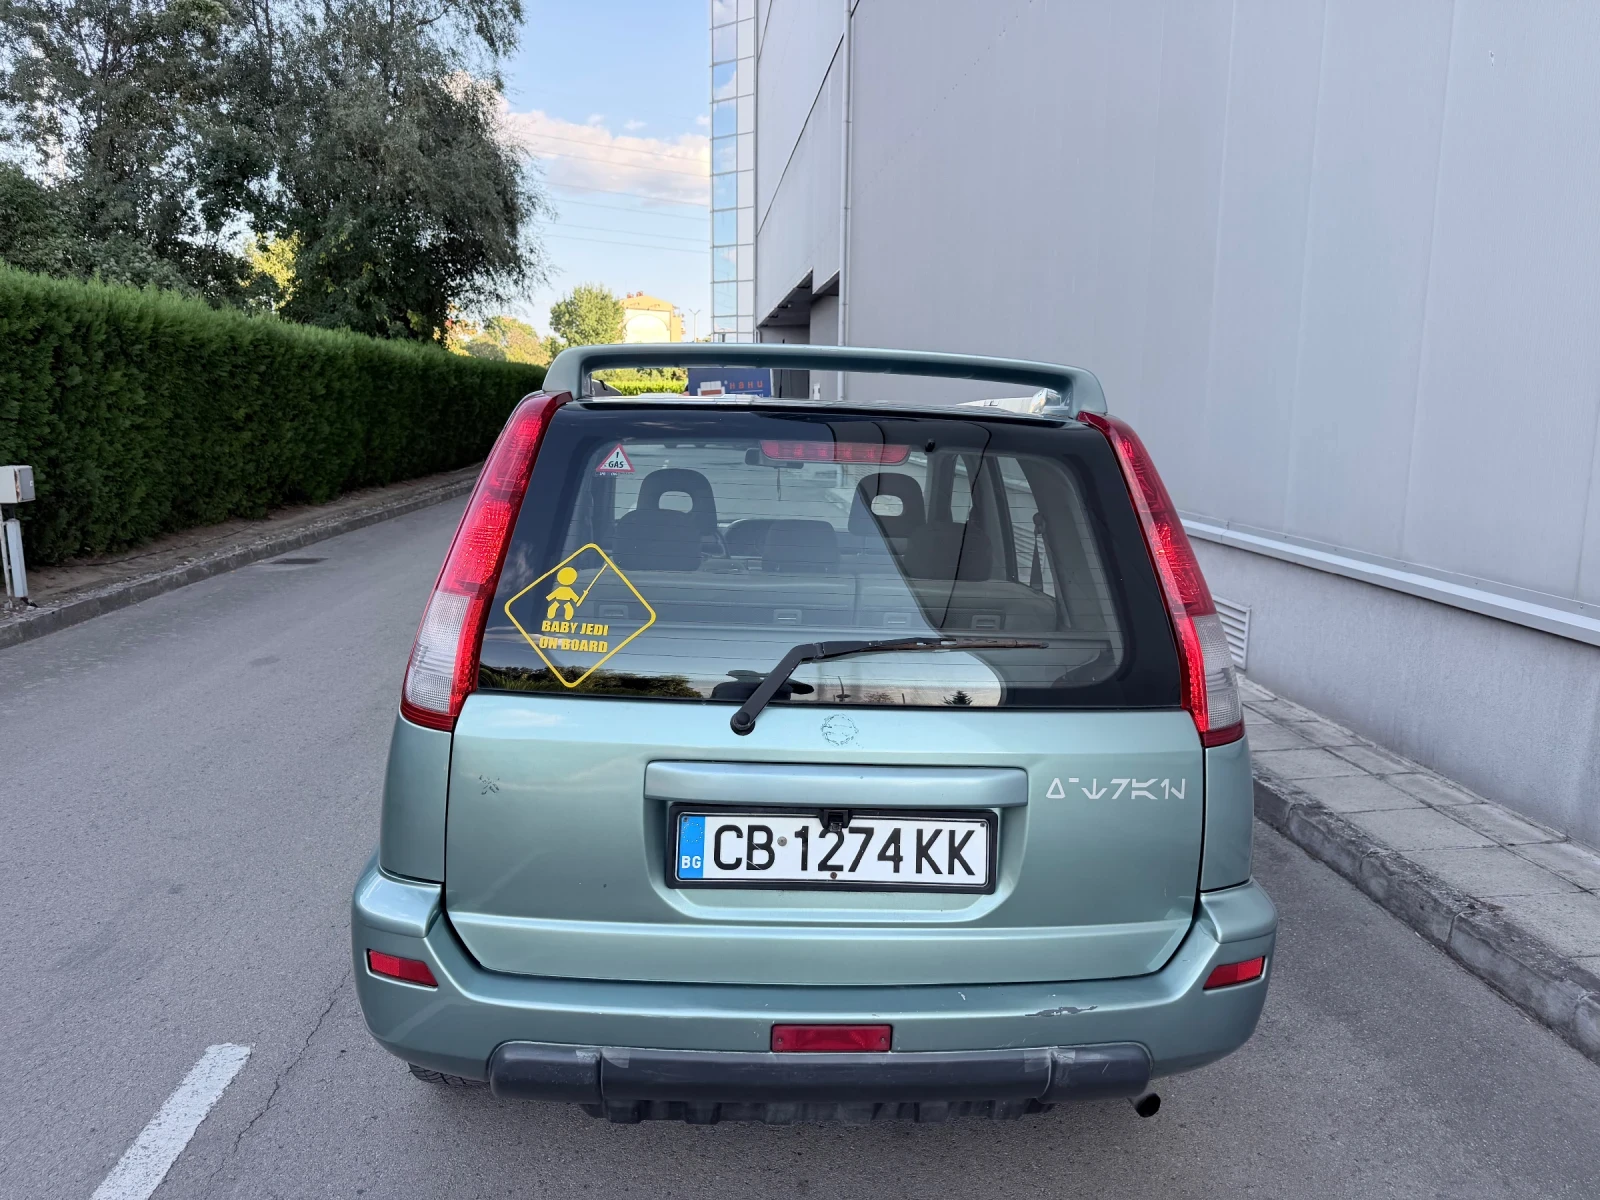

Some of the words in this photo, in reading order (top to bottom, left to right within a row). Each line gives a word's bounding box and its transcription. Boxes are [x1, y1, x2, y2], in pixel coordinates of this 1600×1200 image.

[541, 620, 578, 634] BABY
[580, 623, 609, 636] JEDI
[539, 636, 558, 650] ON
[561, 638, 608, 653] BOARD
[713, 824, 776, 871] CB
[794, 825, 904, 874] 1274
[915, 828, 976, 876] KK
[681, 855, 702, 869] BG
